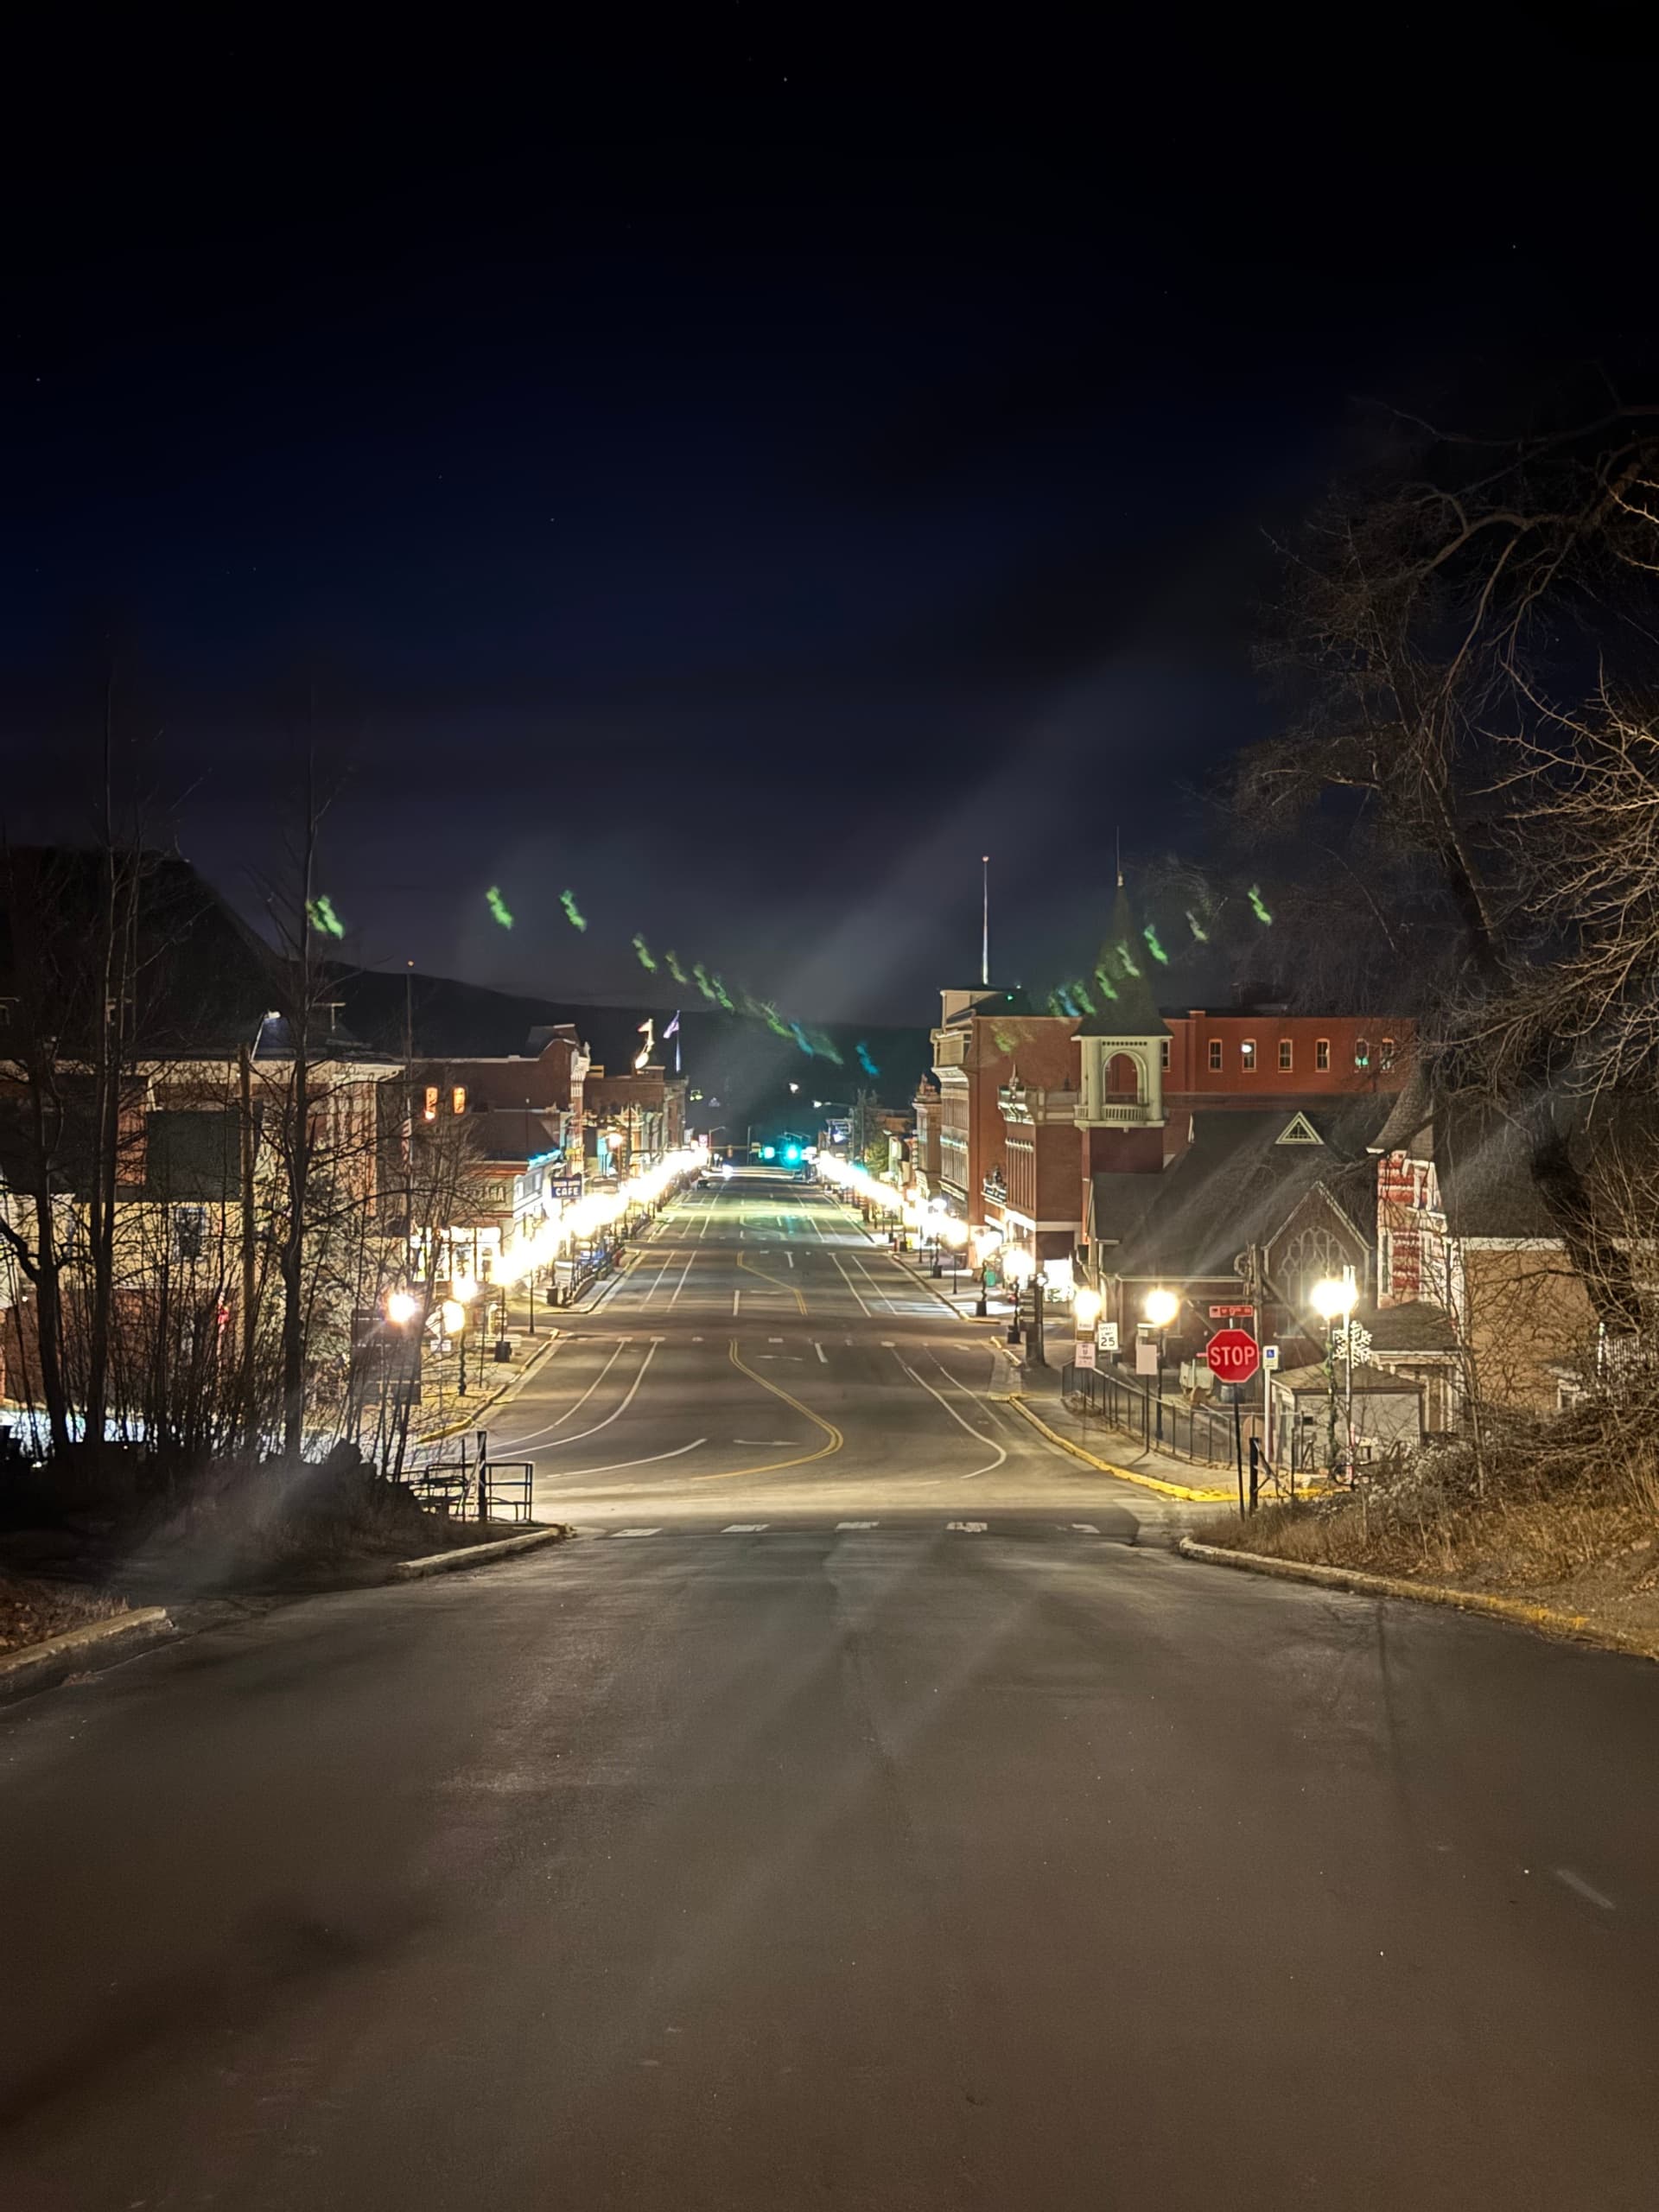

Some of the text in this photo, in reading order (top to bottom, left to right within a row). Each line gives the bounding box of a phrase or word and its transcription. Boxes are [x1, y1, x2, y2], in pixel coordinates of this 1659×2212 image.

[556, 1187, 578, 1196] CAFE
[1101, 1337, 1116, 1347] 25
[1211, 1346, 1255, 1366] STOP
